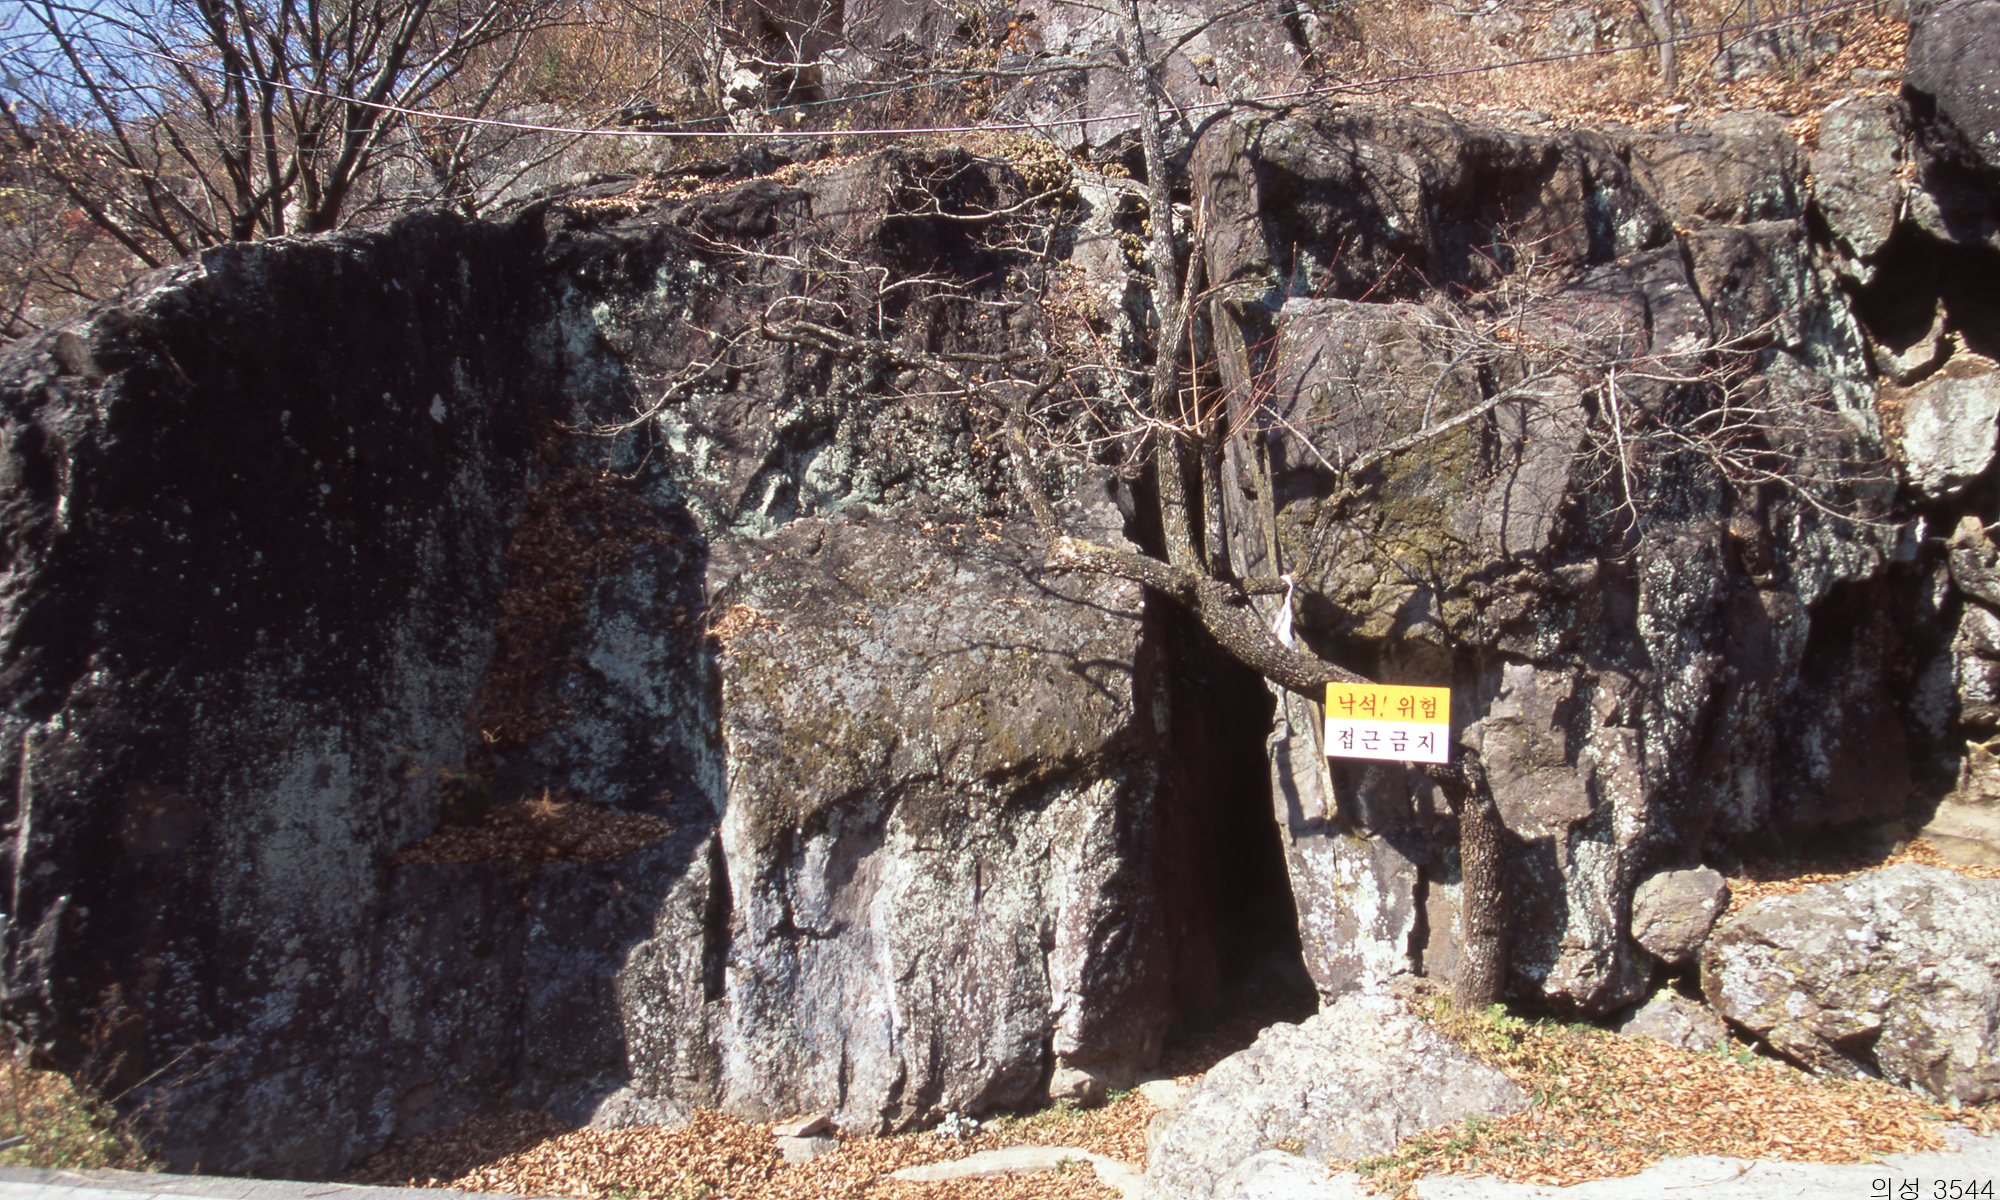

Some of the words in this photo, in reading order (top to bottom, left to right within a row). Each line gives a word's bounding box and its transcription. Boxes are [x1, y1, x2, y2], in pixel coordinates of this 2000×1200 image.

[1338, 692, 1387, 718] 낙석!
[1397, 695, 1437, 719] 위험
[1338, 727, 1434, 754] 접근금지
